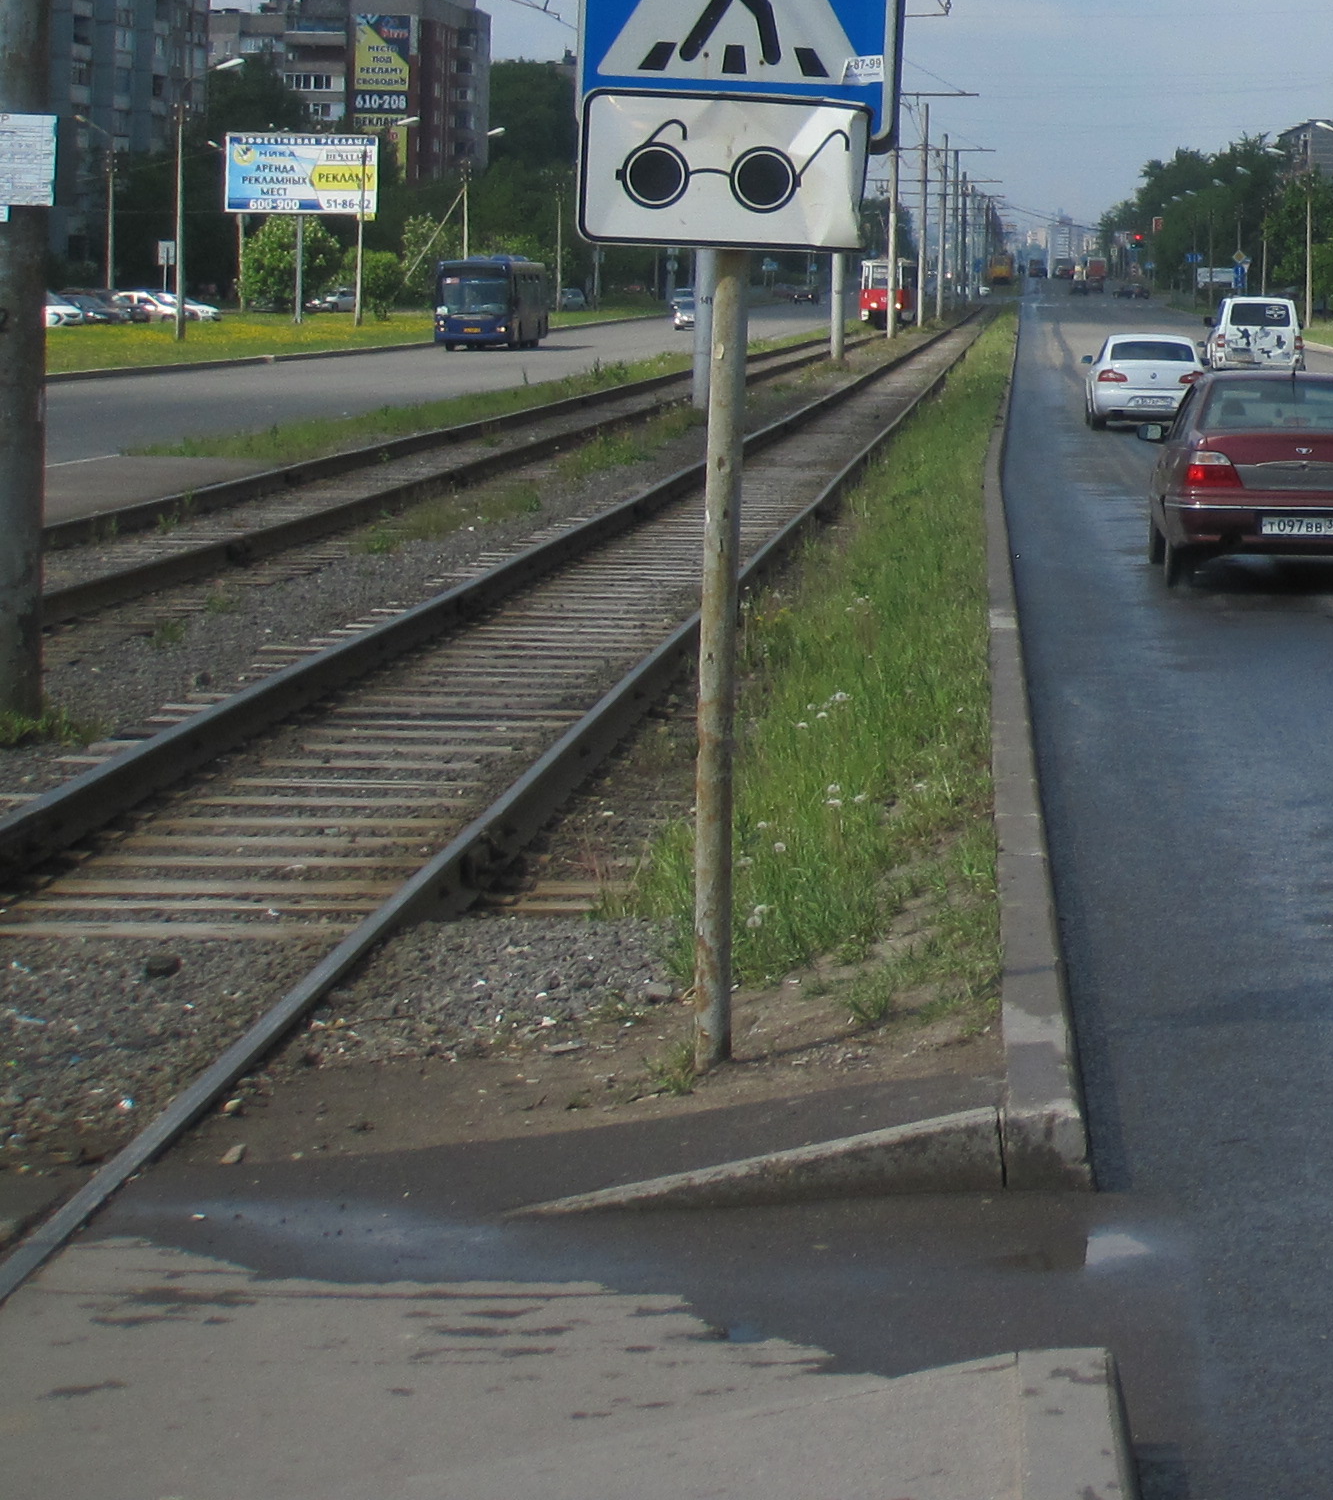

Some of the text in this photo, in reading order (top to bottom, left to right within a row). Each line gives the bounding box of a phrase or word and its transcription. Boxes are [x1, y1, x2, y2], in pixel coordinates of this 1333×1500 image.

[255, 164, 296, 173] АРЕНДА
[241, 176, 308, 185] РЕКЛАМНЫХ
[260, 188, 288, 197] МЕСТ
[249, 199, 300, 210] 600-900
